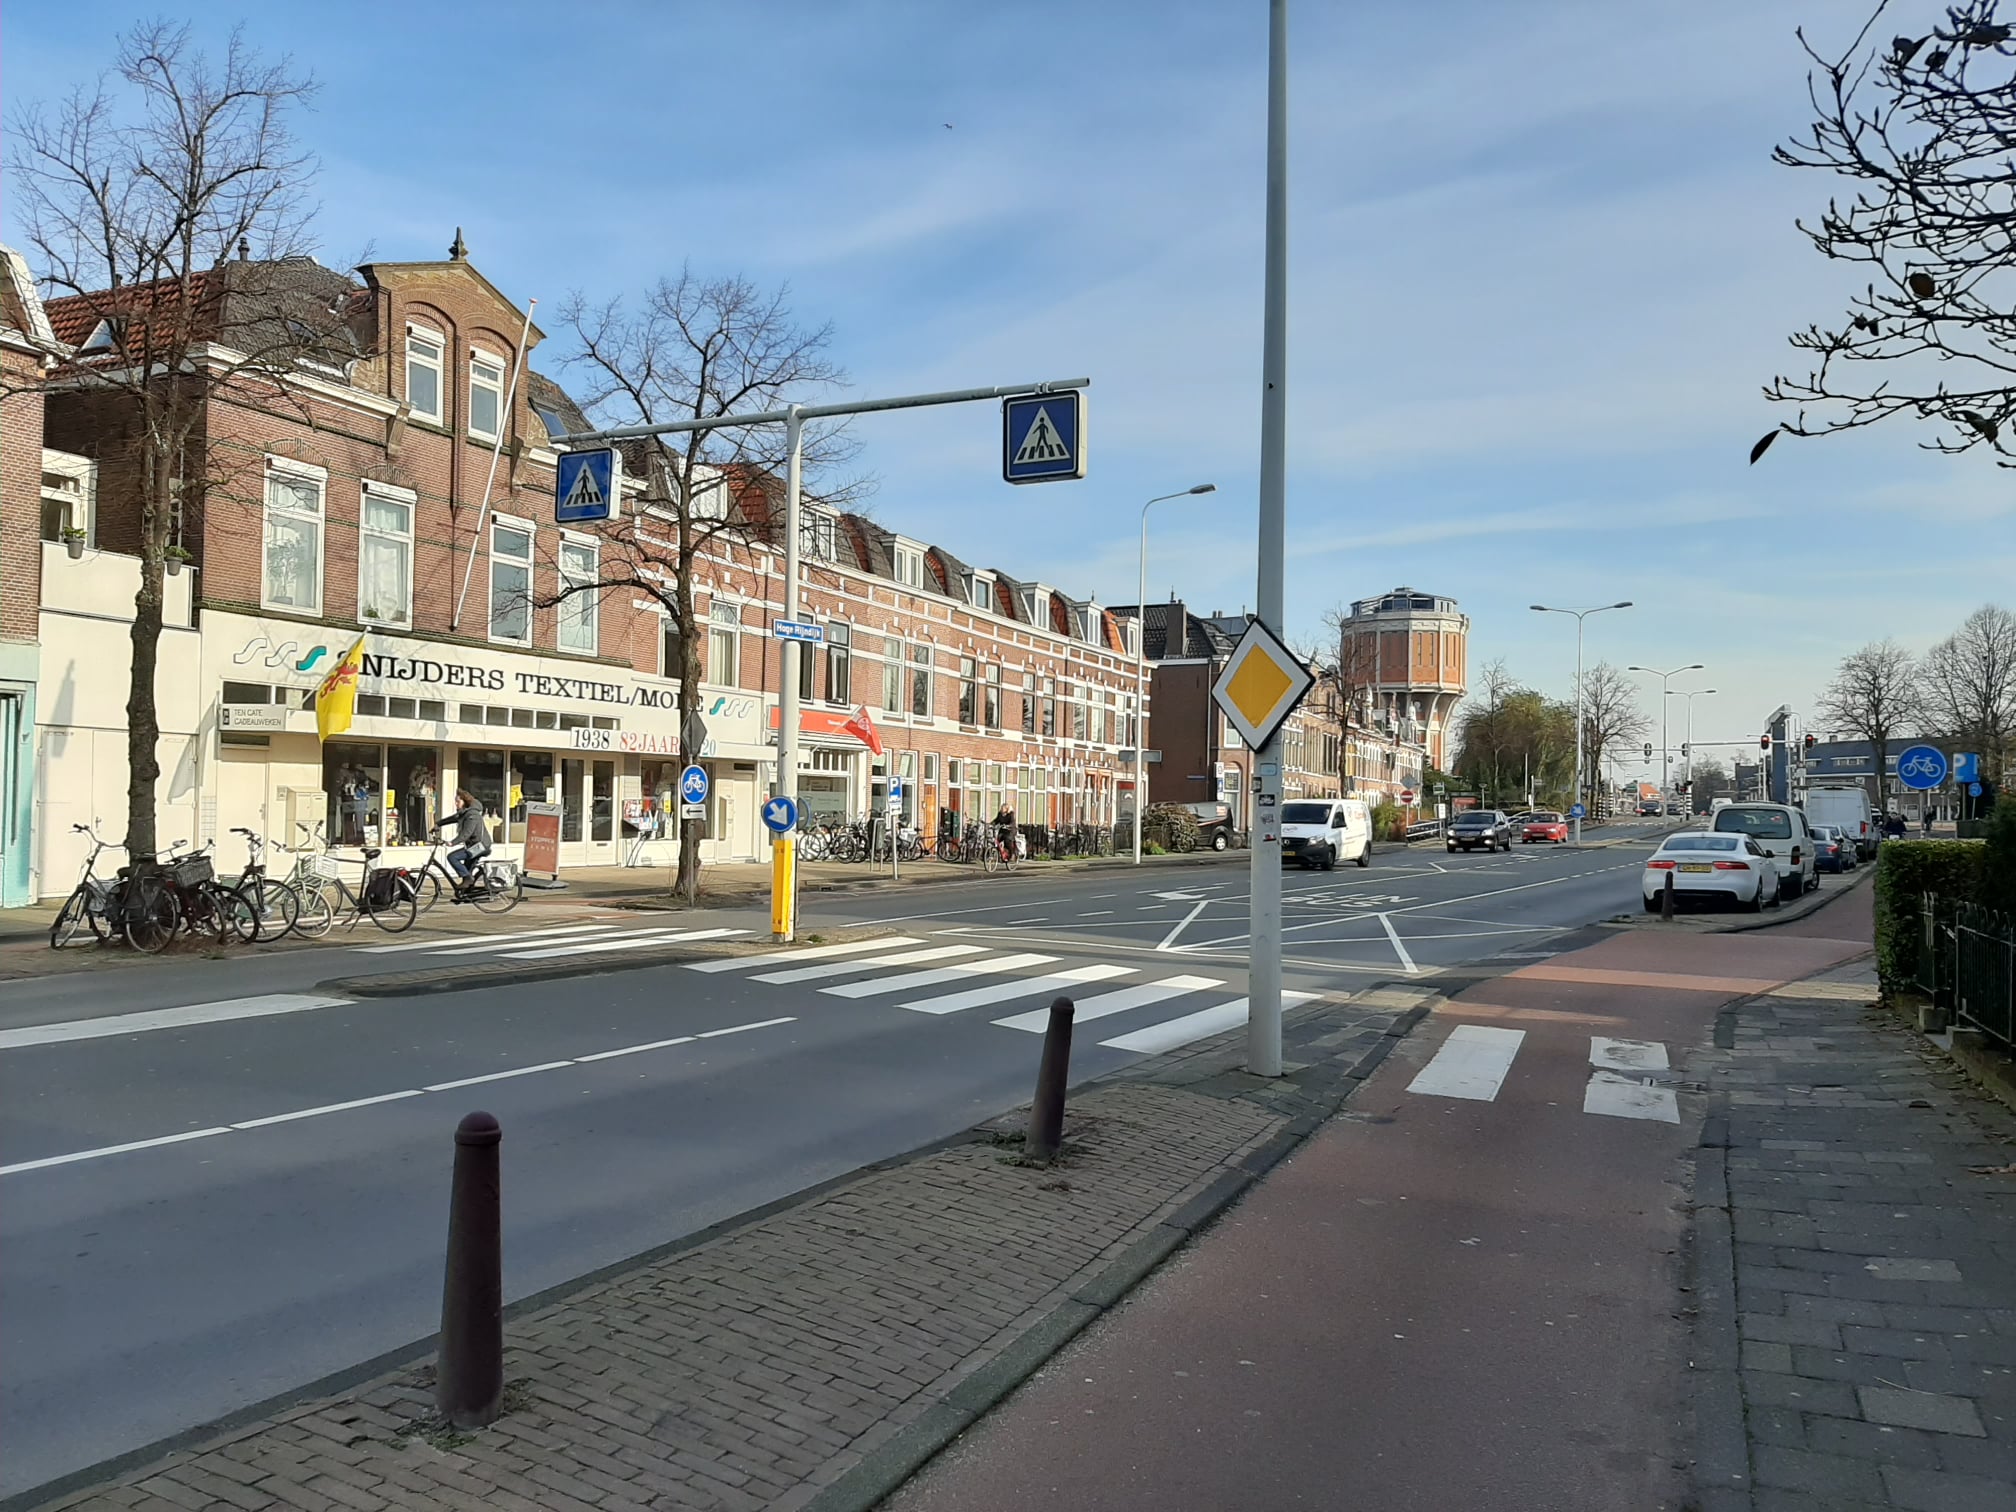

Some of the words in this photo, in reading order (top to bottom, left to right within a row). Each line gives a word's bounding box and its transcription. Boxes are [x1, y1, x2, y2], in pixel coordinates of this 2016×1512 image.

[776, 622, 794, 636] Hoge
[794, 625, 821, 639] Rijndijk
[337, 650, 505, 691] NIJDERS
[574, 728, 611, 750] 1938
